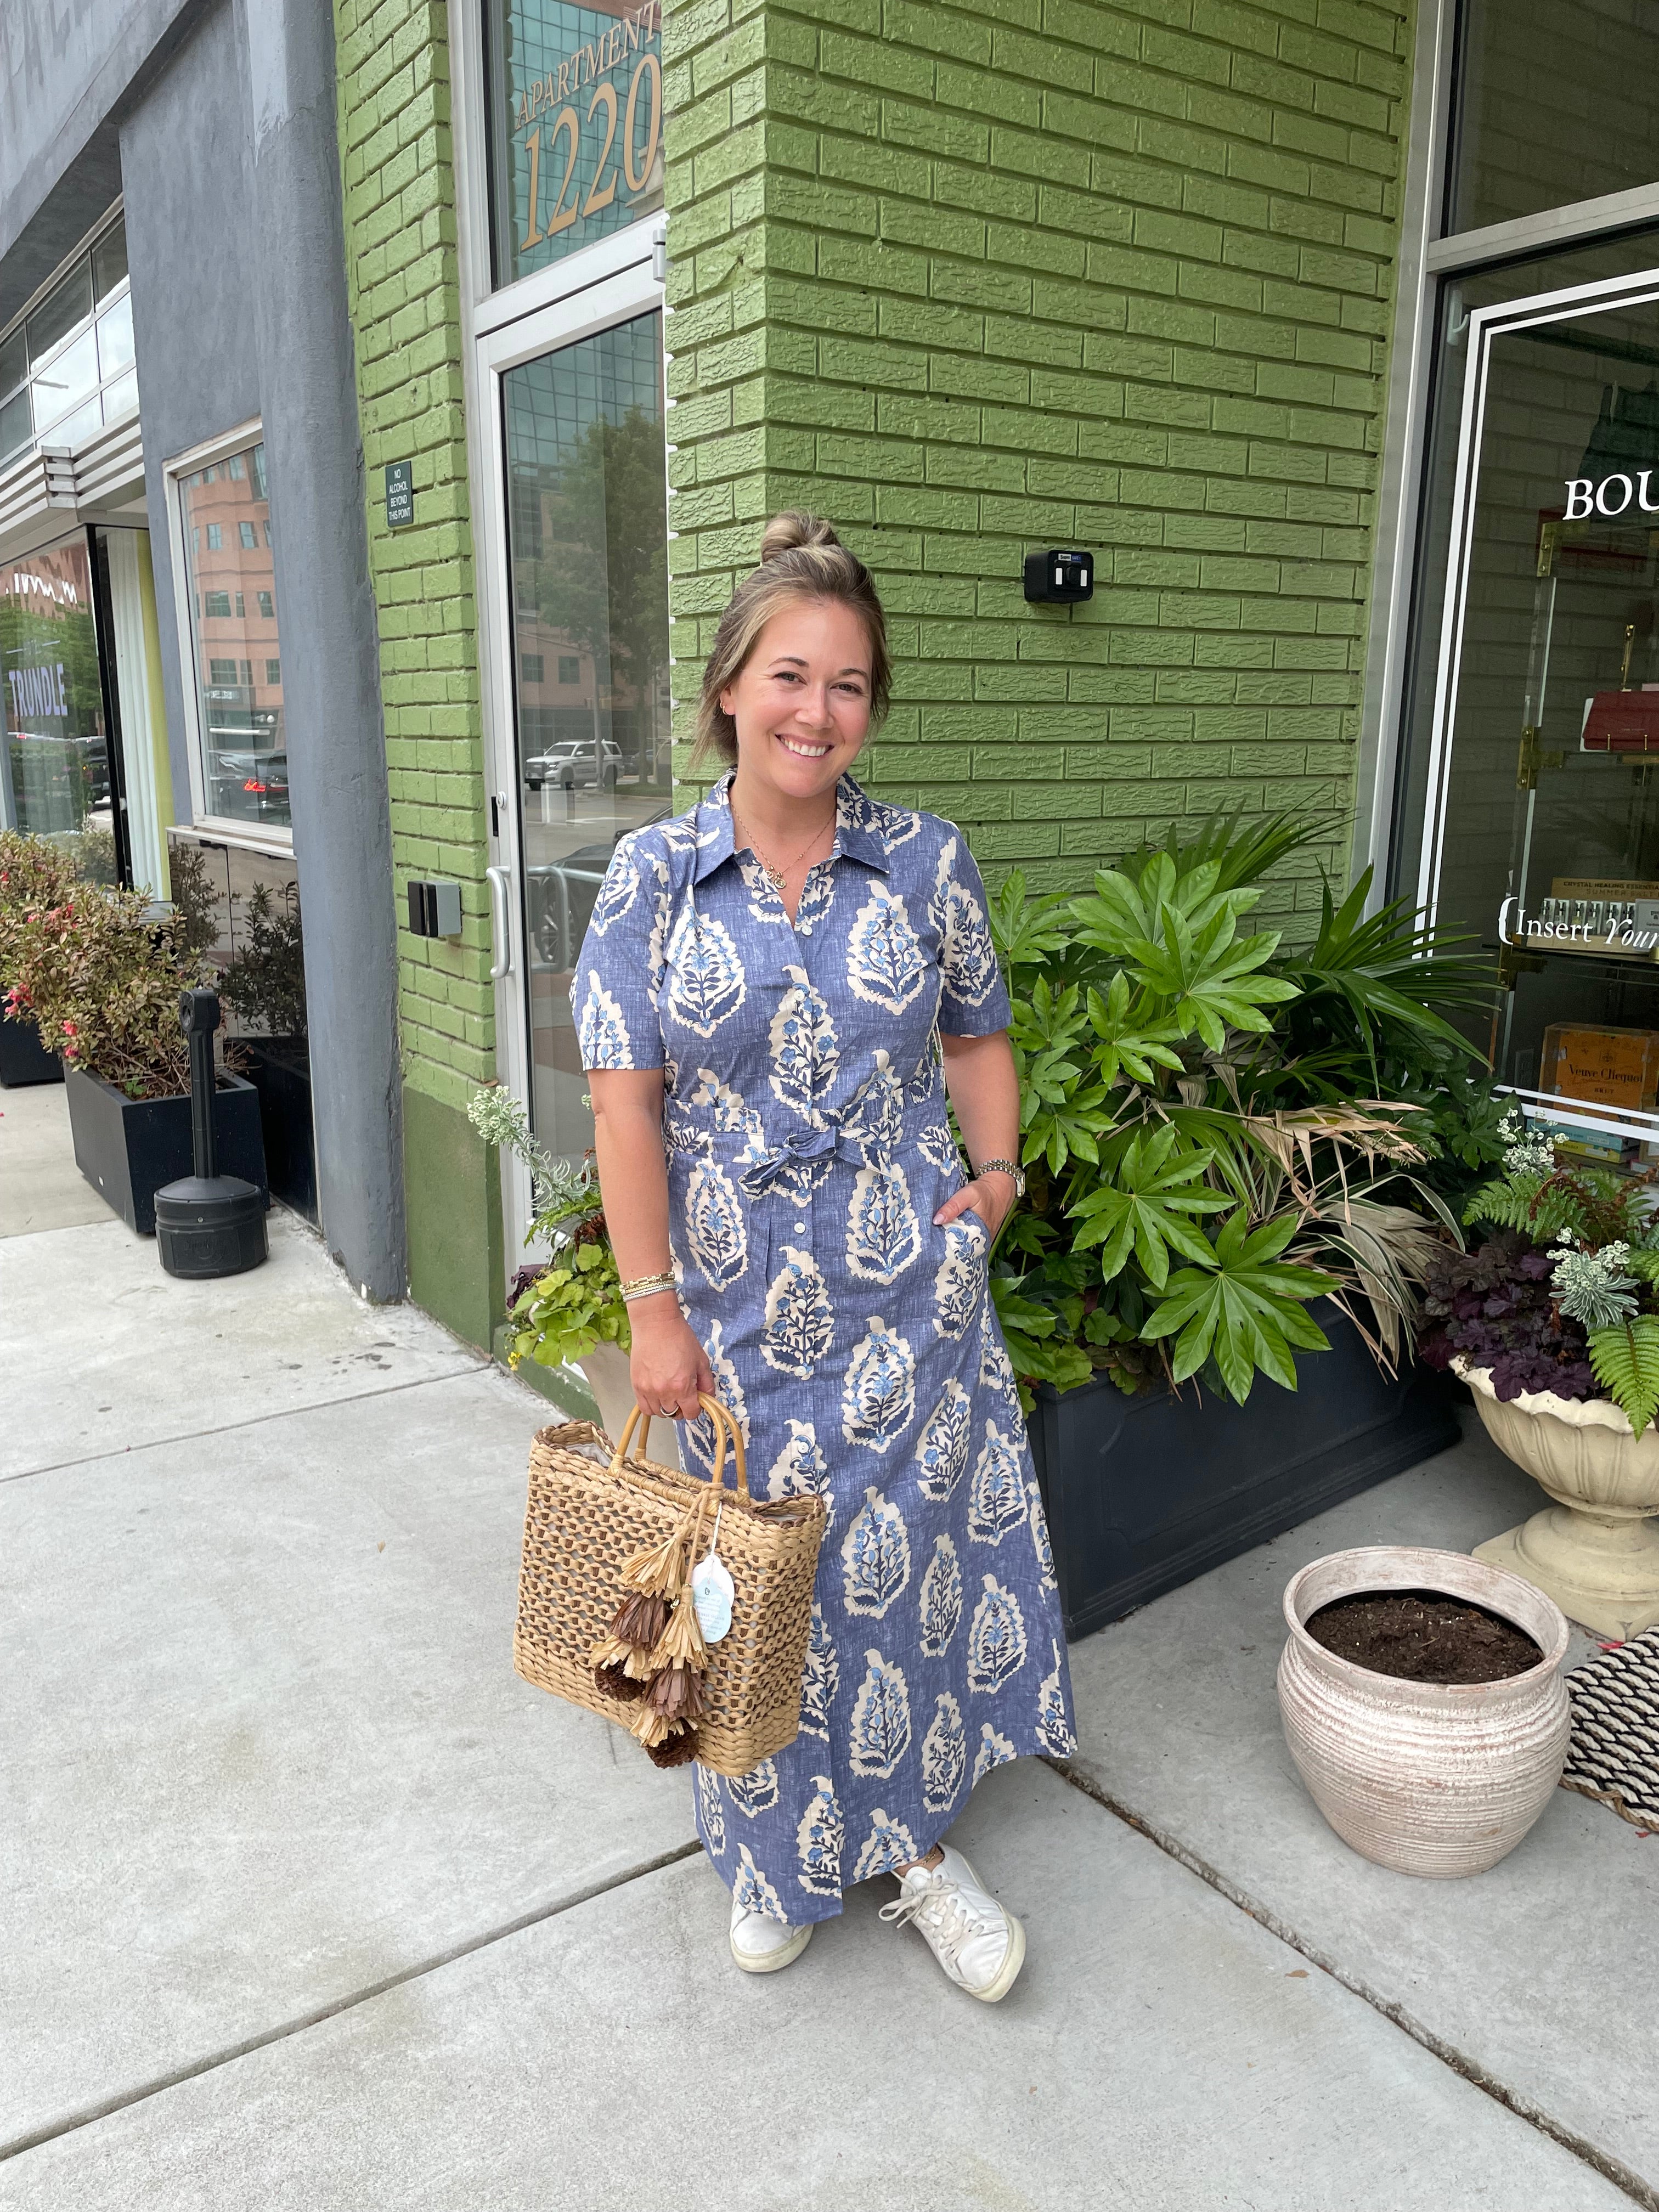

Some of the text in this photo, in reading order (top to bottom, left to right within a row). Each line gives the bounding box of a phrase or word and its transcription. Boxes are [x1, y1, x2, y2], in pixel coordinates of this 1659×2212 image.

[514, 0, 659, 130] APARTMENT
[521, 54, 661, 252] 1220
[394, 469, 401, 478] NO
[389, 481, 408, 494] ALCOHOL
[390, 494, 407, 507] BEYOND
[1562, 470, 1659, 520] BOU
[388, 507, 410, 521] THIS POINT
[9, 663, 68, 716] TRUNDLE
[1569, 1064, 1598, 1077] Veuve
